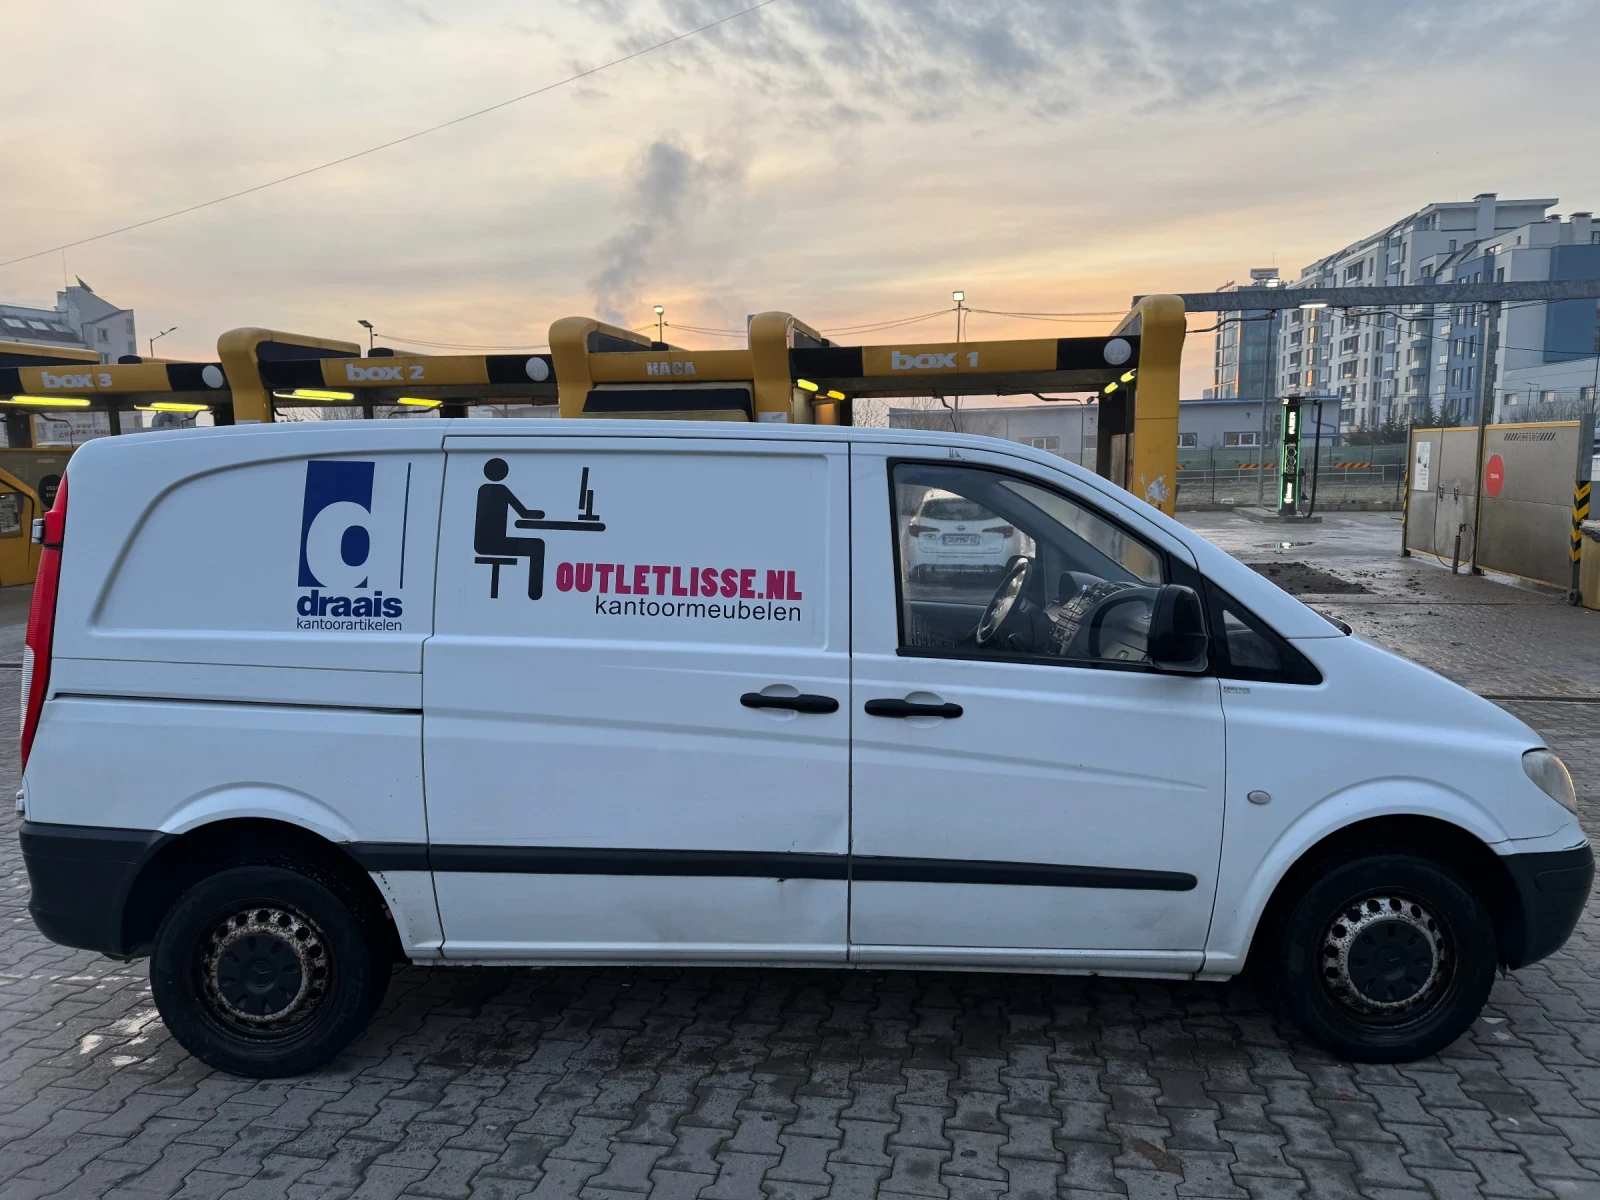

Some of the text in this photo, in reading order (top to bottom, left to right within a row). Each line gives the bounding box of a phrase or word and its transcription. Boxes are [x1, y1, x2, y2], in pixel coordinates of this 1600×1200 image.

[892, 350, 979, 370] box 1
[41, 371, 113, 389] box 3
[345, 363, 425, 381] box 2
[556, 562, 803, 601] OUTLETLISSE.NL
[296, 589, 403, 618] draais
[595, 595, 801, 622] kantoormeubelen
[296, 617, 402, 631] kantoorartikelen
